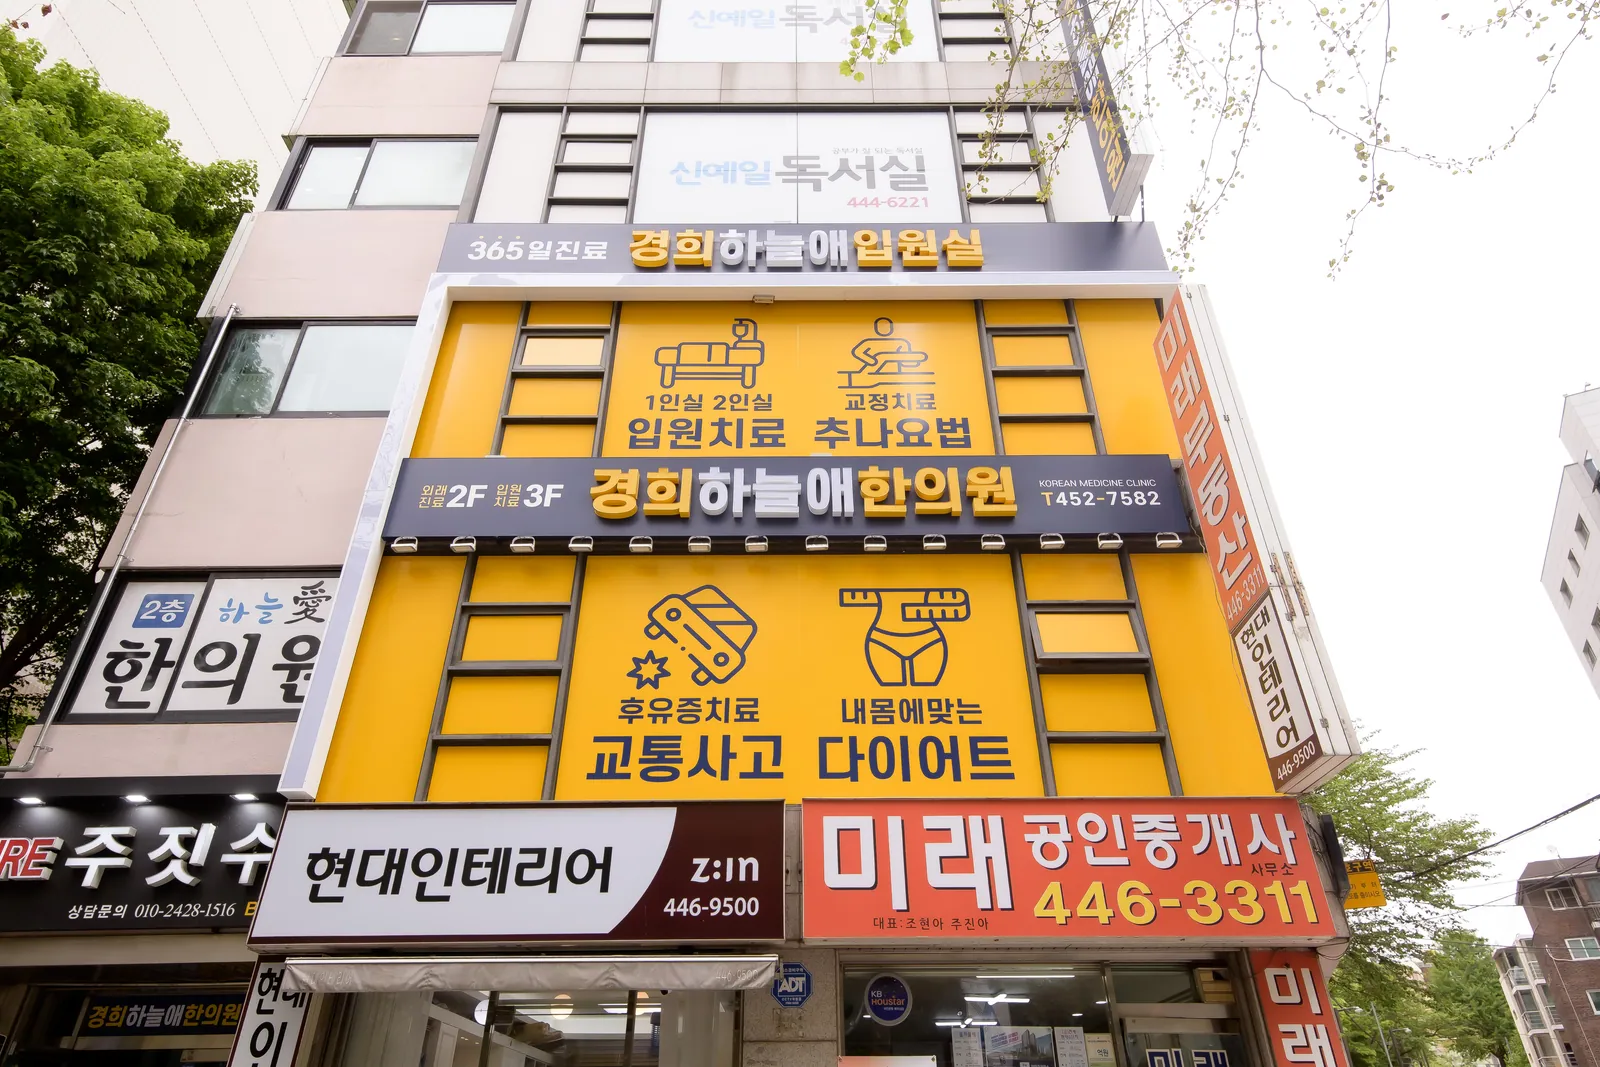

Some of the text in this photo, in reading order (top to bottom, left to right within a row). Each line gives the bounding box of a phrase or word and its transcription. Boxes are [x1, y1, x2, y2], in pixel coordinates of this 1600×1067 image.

[847, 197, 929, 208] 444-6221
[645, 394, 773, 412] 1인실 2인실
[845, 393, 937, 411] 교정치료
[628, 418, 786, 449] 입원치료
[814, 417, 972, 449] 추나요법
[1157, 303, 1254, 592] 미래부동산
[420, 484, 448, 496] 외래
[496, 484, 522, 496] 입원
[1080, 479, 1124, 487] MEDICINE
[1126, 479, 1157, 487] CLINIC
[418, 497, 445, 508] 진료
[446, 484, 488, 508] 2F
[493, 496, 520, 507] 치료
[523, 483, 564, 508] 3F
[1226, 564, 1265, 621] 446-3311
[140, 599, 185, 623] 2층
[618, 697, 760, 724] 후유증치료
[841, 698, 983, 724] 내몸에맞는
[586, 734, 785, 783] 교통사고
[818, 735, 1016, 782] 다이어트
[1276, 740, 1316, 781] 446-9500
[1023, 812, 1298, 870] 공인중개사
[0, 836, 64, 880] RE
[822, 815, 1013, 912] 미래
[1251, 862, 1295, 877] 사무소
[306, 846, 614, 904] 현대인테리어
[68, 904, 128, 920] 상담문의
[134, 903, 236, 919] 010-2428-1516
[663, 897, 760, 917] 446-9500
[1033, 879, 1320, 926] 446-3311
[951, 917, 989, 930] 주진아
[778, 976, 806, 992] ADT
